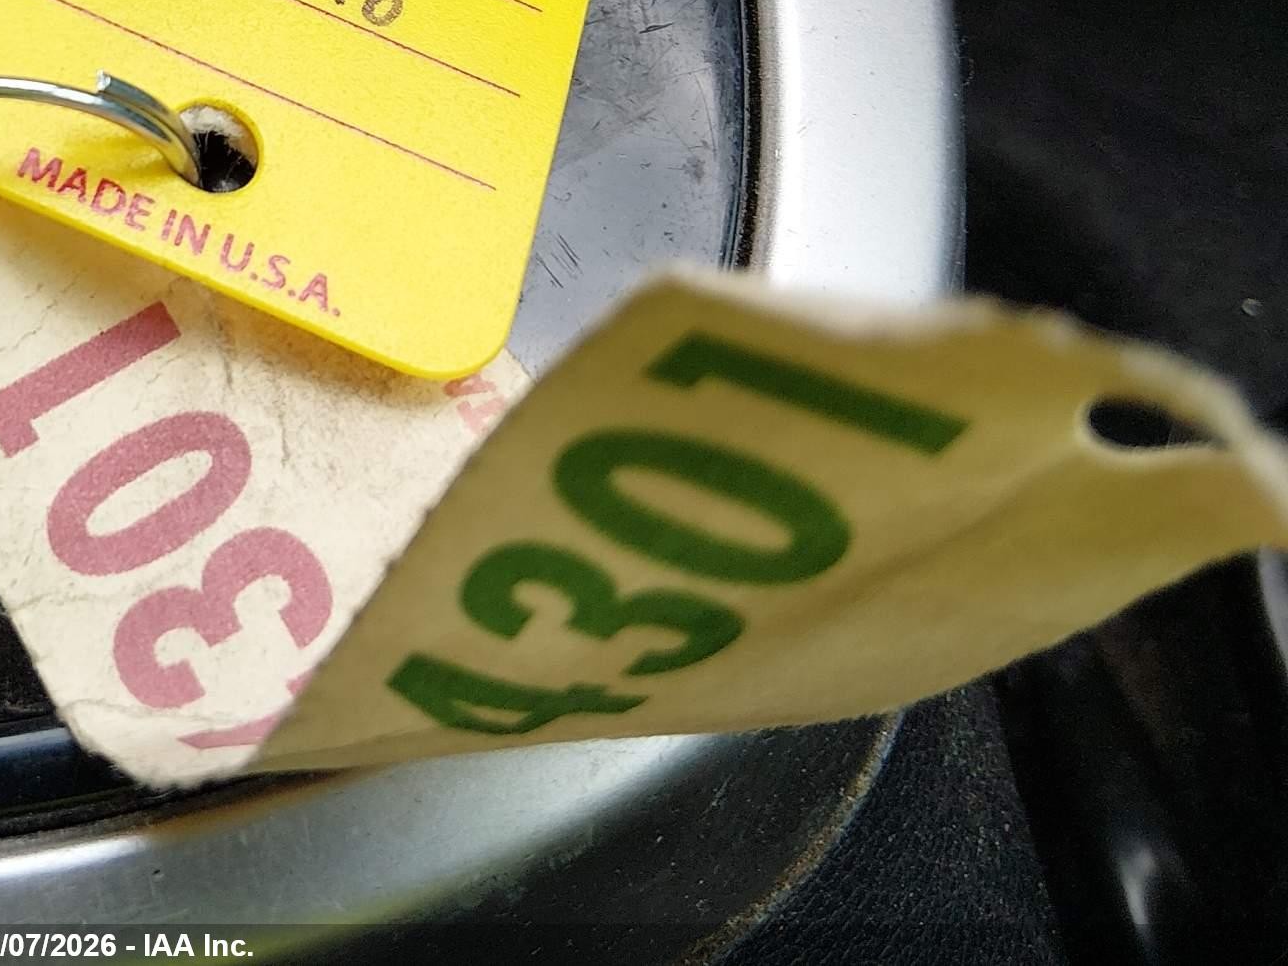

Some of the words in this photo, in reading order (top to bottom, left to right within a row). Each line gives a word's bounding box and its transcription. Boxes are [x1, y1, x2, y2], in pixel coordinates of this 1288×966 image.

[17, 147, 153, 232] MADE
[161, 208, 212, 255] IN
[220, 233, 342, 319] U.S.A.
[386, 331, 972, 735] 4301
